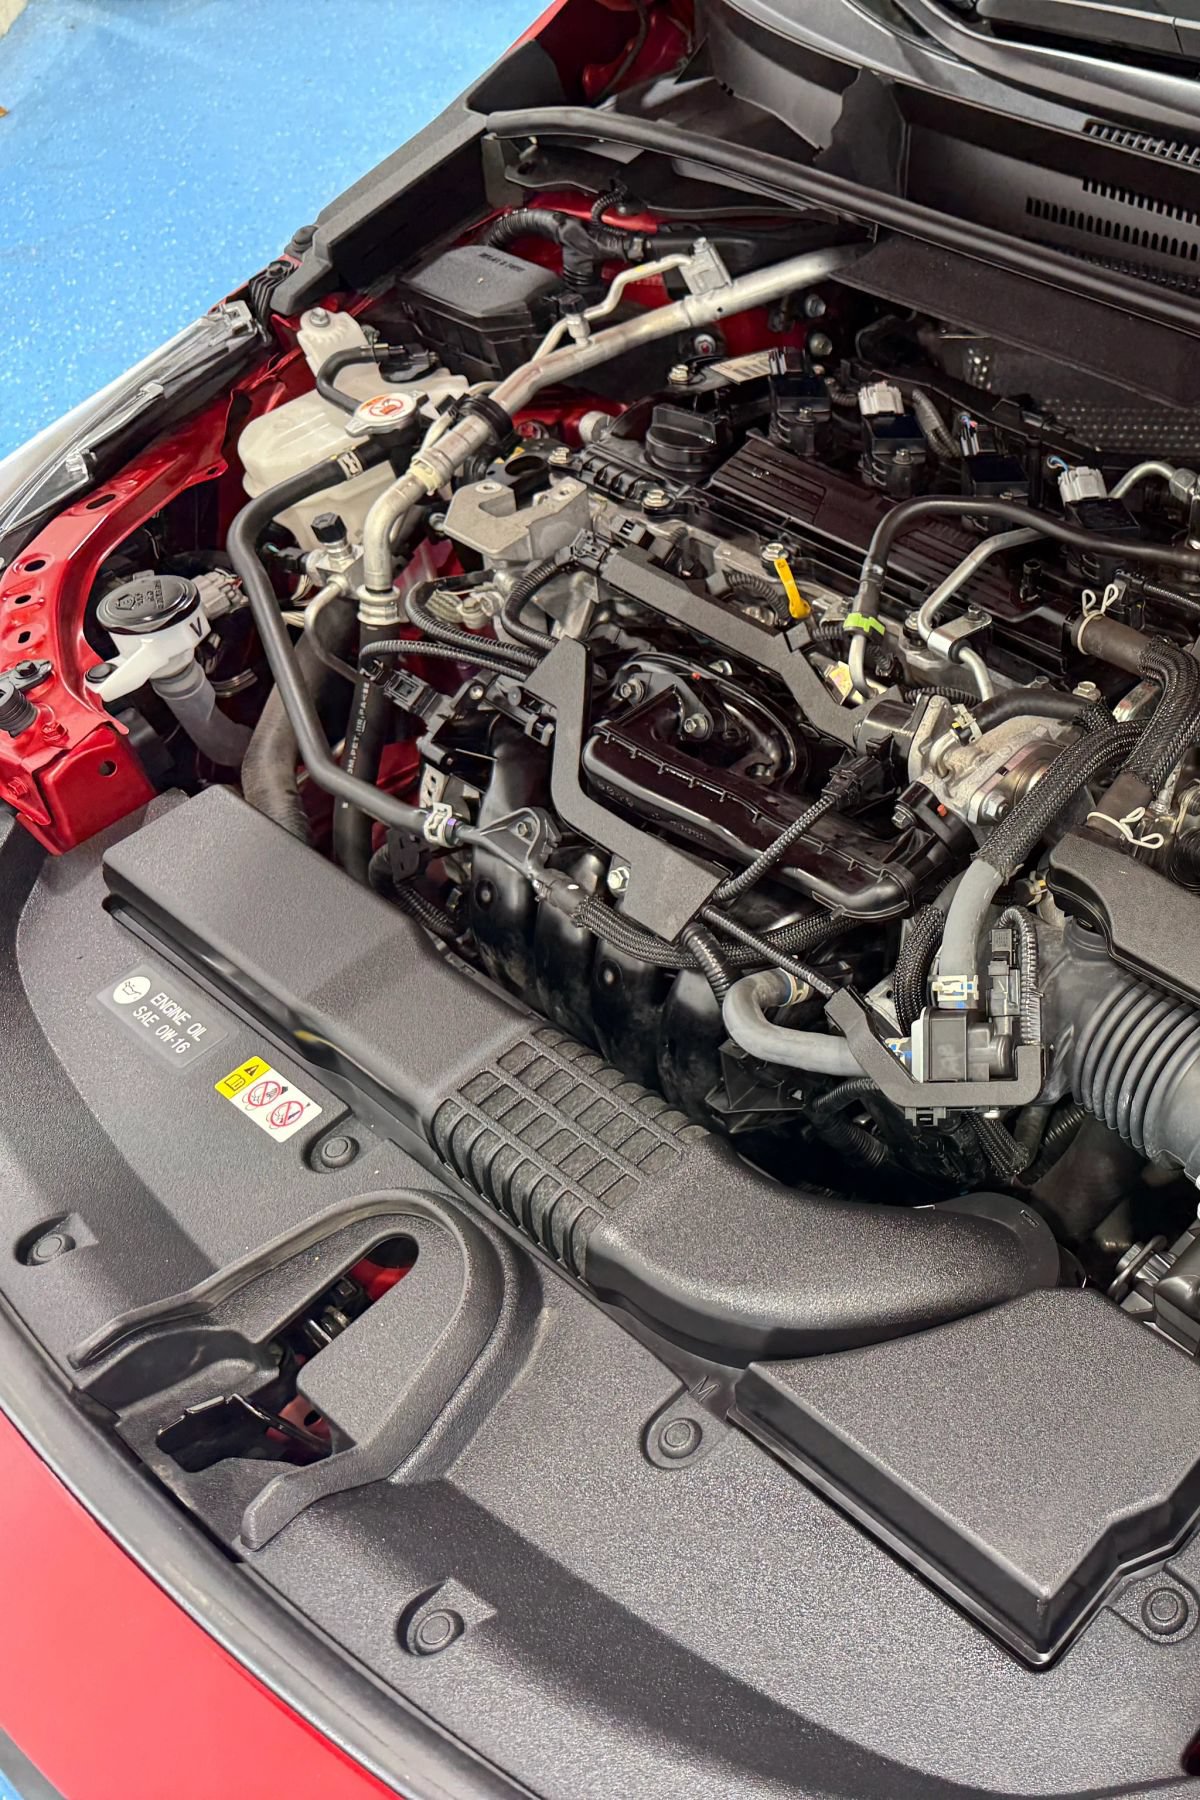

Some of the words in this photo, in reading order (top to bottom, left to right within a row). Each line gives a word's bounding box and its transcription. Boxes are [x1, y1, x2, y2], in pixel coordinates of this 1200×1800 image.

[190, 617, 203, 638] V
[132, 1006, 160, 1027] SAE
[155, 1025, 191, 1054] 0W-16
[150, 992, 192, 1026] ENGINE
[186, 1023, 207, 1041] OIL
